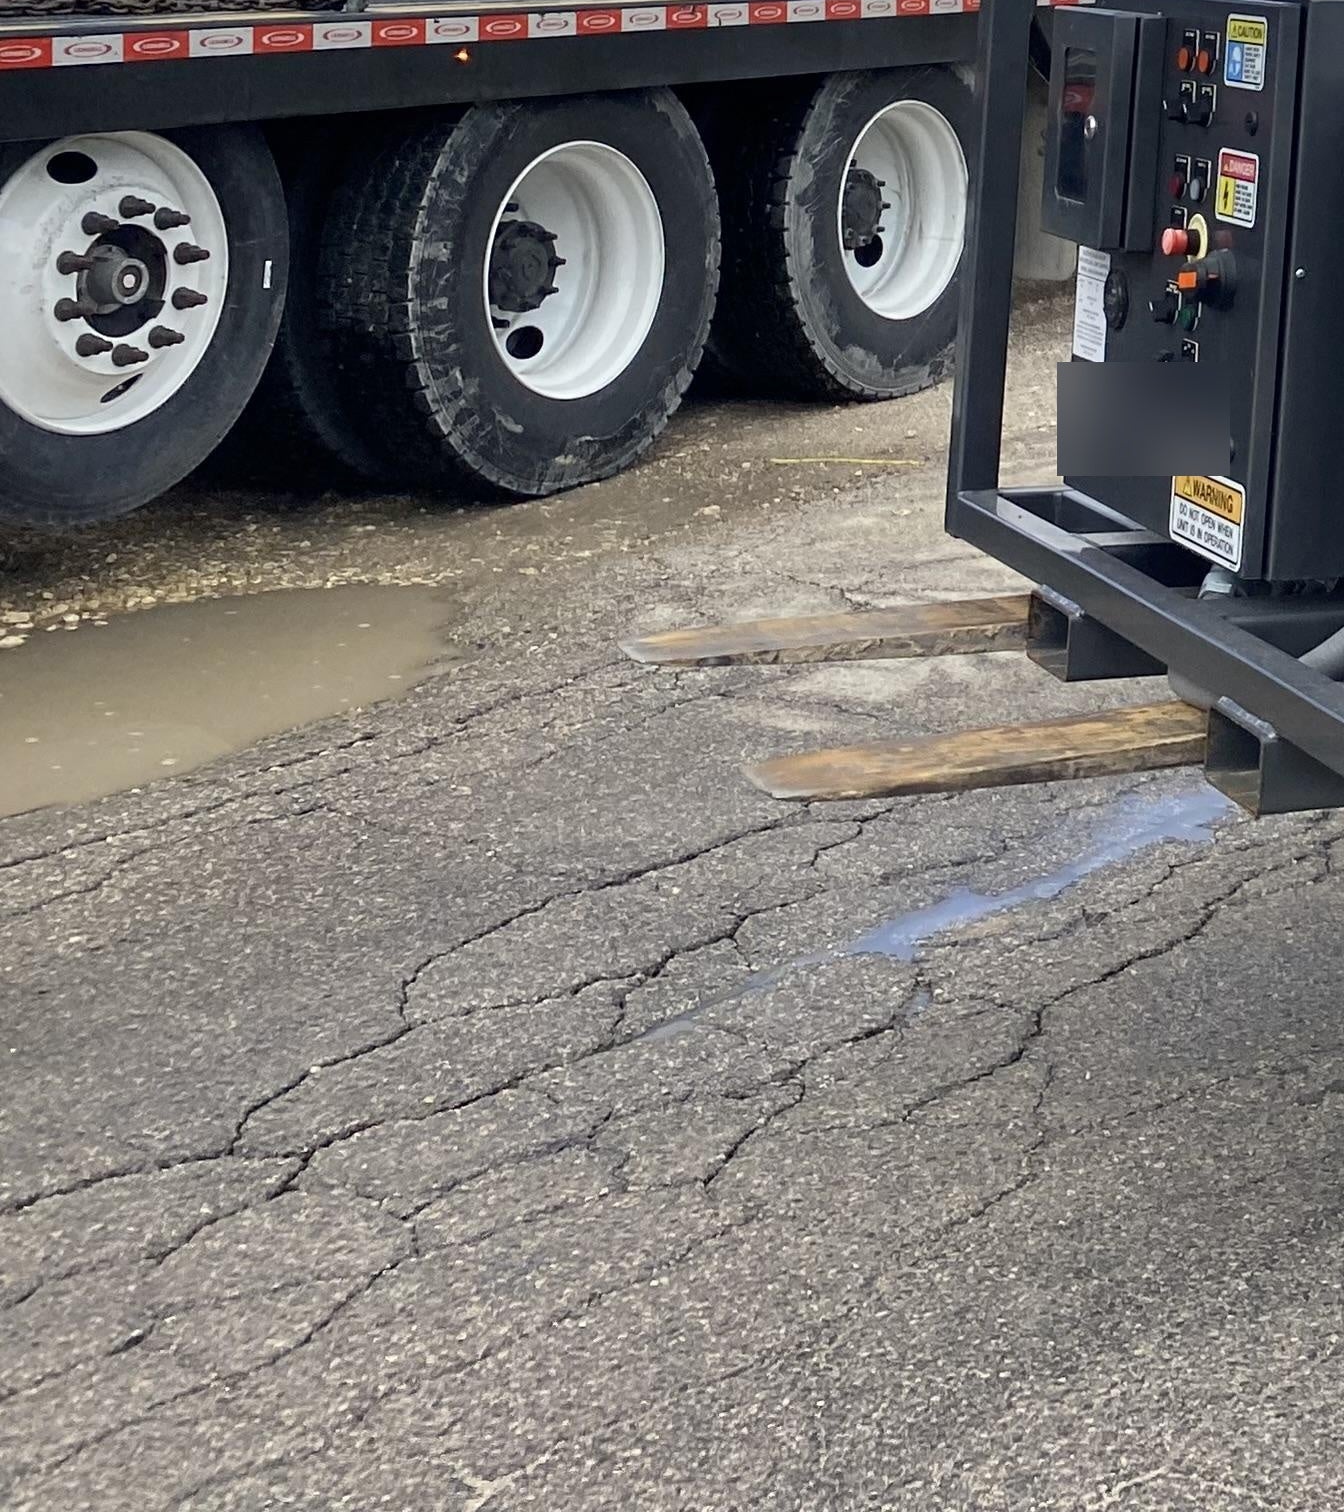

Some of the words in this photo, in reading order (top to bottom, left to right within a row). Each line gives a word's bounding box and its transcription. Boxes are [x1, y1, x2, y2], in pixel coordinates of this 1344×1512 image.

[1237, 25, 1263, 40] CAUTION
[1193, 480, 1234, 514] WARNING
[1176, 518, 1189, 533] UNIT
[1190, 524, 1196, 537] IS
[1197, 528, 1203, 540] IN
[1204, 531, 1234, 556] OPERATION
[1179, 502, 1188, 516] DO
[1189, 508, 1200, 522] NOT
[1201, 513, 1216, 530] OPEN
[1217, 520, 1233, 539] WHEN
